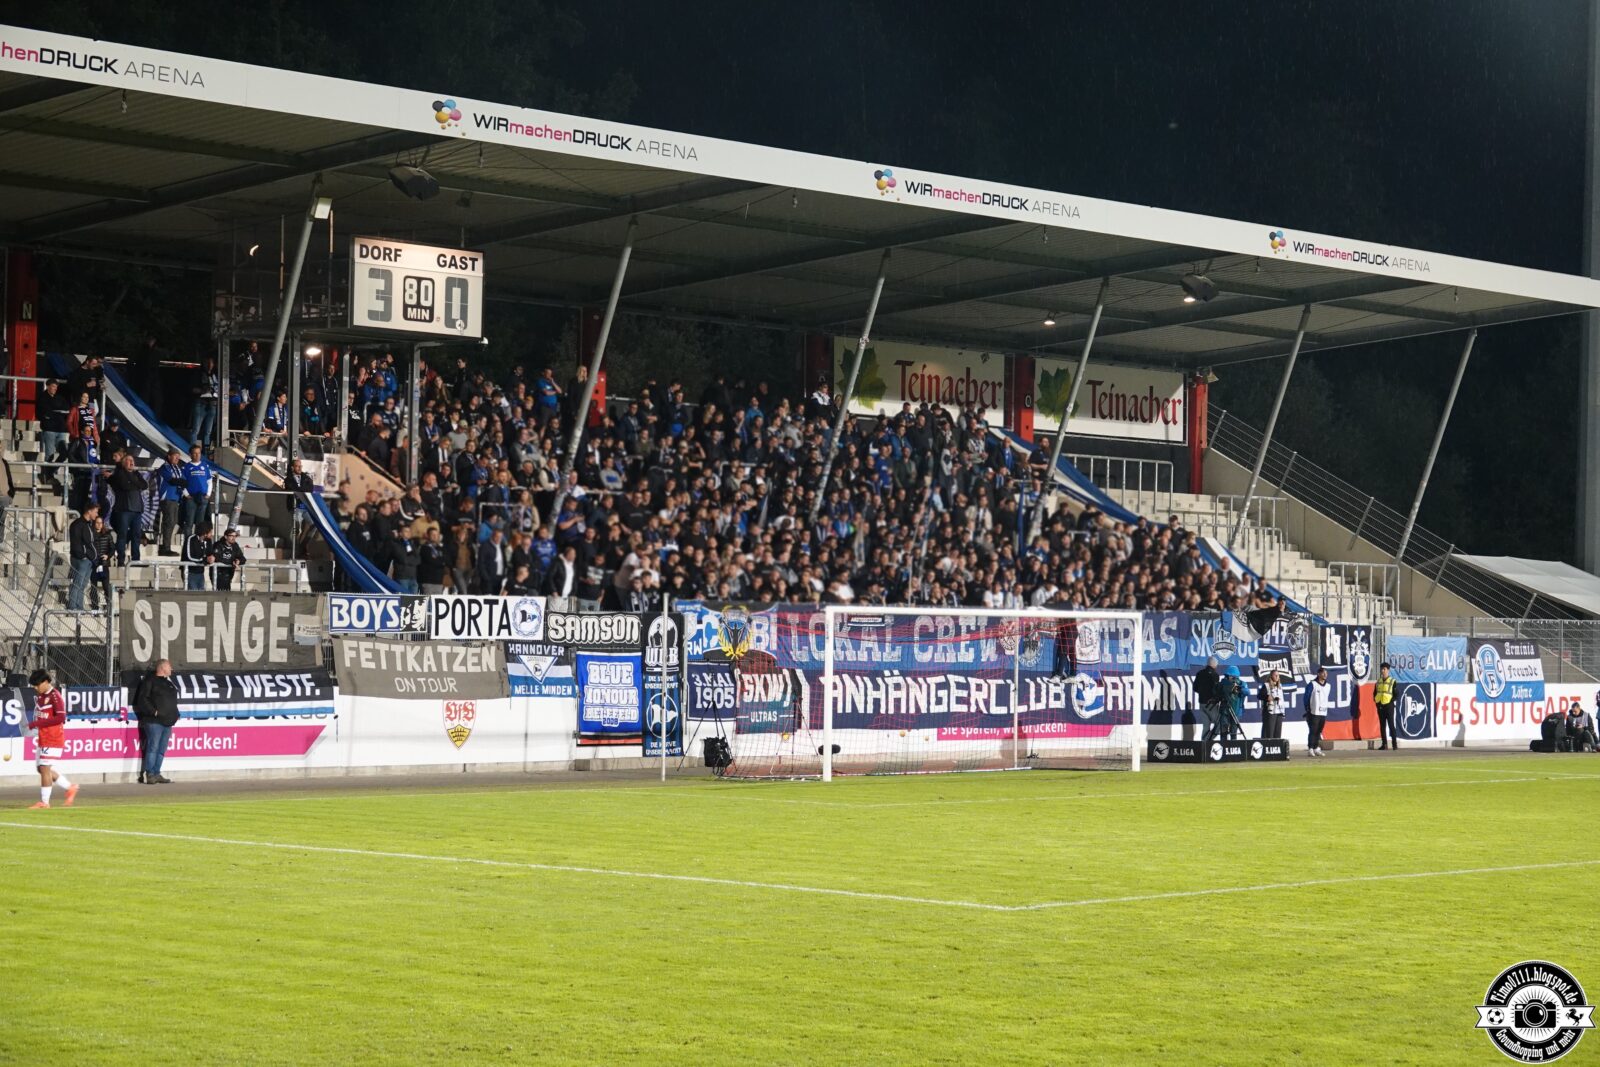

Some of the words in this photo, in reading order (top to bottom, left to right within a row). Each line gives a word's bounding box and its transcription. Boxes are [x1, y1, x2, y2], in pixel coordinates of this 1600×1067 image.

[124, 61, 204, 88] ARENA
[473, 112, 632, 152] WIRmachenDRUCK
[636, 139, 698, 161] ARENA
[905, 180, 1029, 211] WIRmachenDRUCK
[1031, 200, 1080, 219] ARENA
[360, 244, 402, 262] DORF
[437, 253, 478, 271] GAST
[1293, 241, 1389, 267] WIRmachenDRUCK
[1391, 257, 1430, 273] ARENA
[367, 267, 393, 322] 3
[404, 277, 433, 307] 80
[444, 276, 469, 330] 0
[407, 307, 430, 320] MIN
[894, 359, 1003, 409] Teinacher
[1086, 379, 1182, 426] Teinacher
[331, 597, 400, 632] BOYS
[434, 598, 512, 637] PORTA
[132, 599, 290, 664] SPENGE
[548, 613, 641, 645] SAMSON
[787, 612, 902, 663] LOKAL
[913, 615, 1000, 663] CREW
[342, 639, 496, 673] FETTKATZEN
[508, 643, 565, 657] HANNOVER
[1504, 641, 1535, 656] Arminia
[236, 673, 320, 698] WESTF.
[394, 677, 416, 693] ON
[416, 677, 459, 693] TOUR
[588, 663, 633, 685] BLUE
[541, 684, 573, 696] MINDEN
[695, 687, 735, 709] 1905
[750, 711, 778, 723] ULTRAS
[64, 738, 128, 757] sparen,
[1230, 747, 1241, 755] LIGA
[1270, 746, 1281, 754] LIGA
